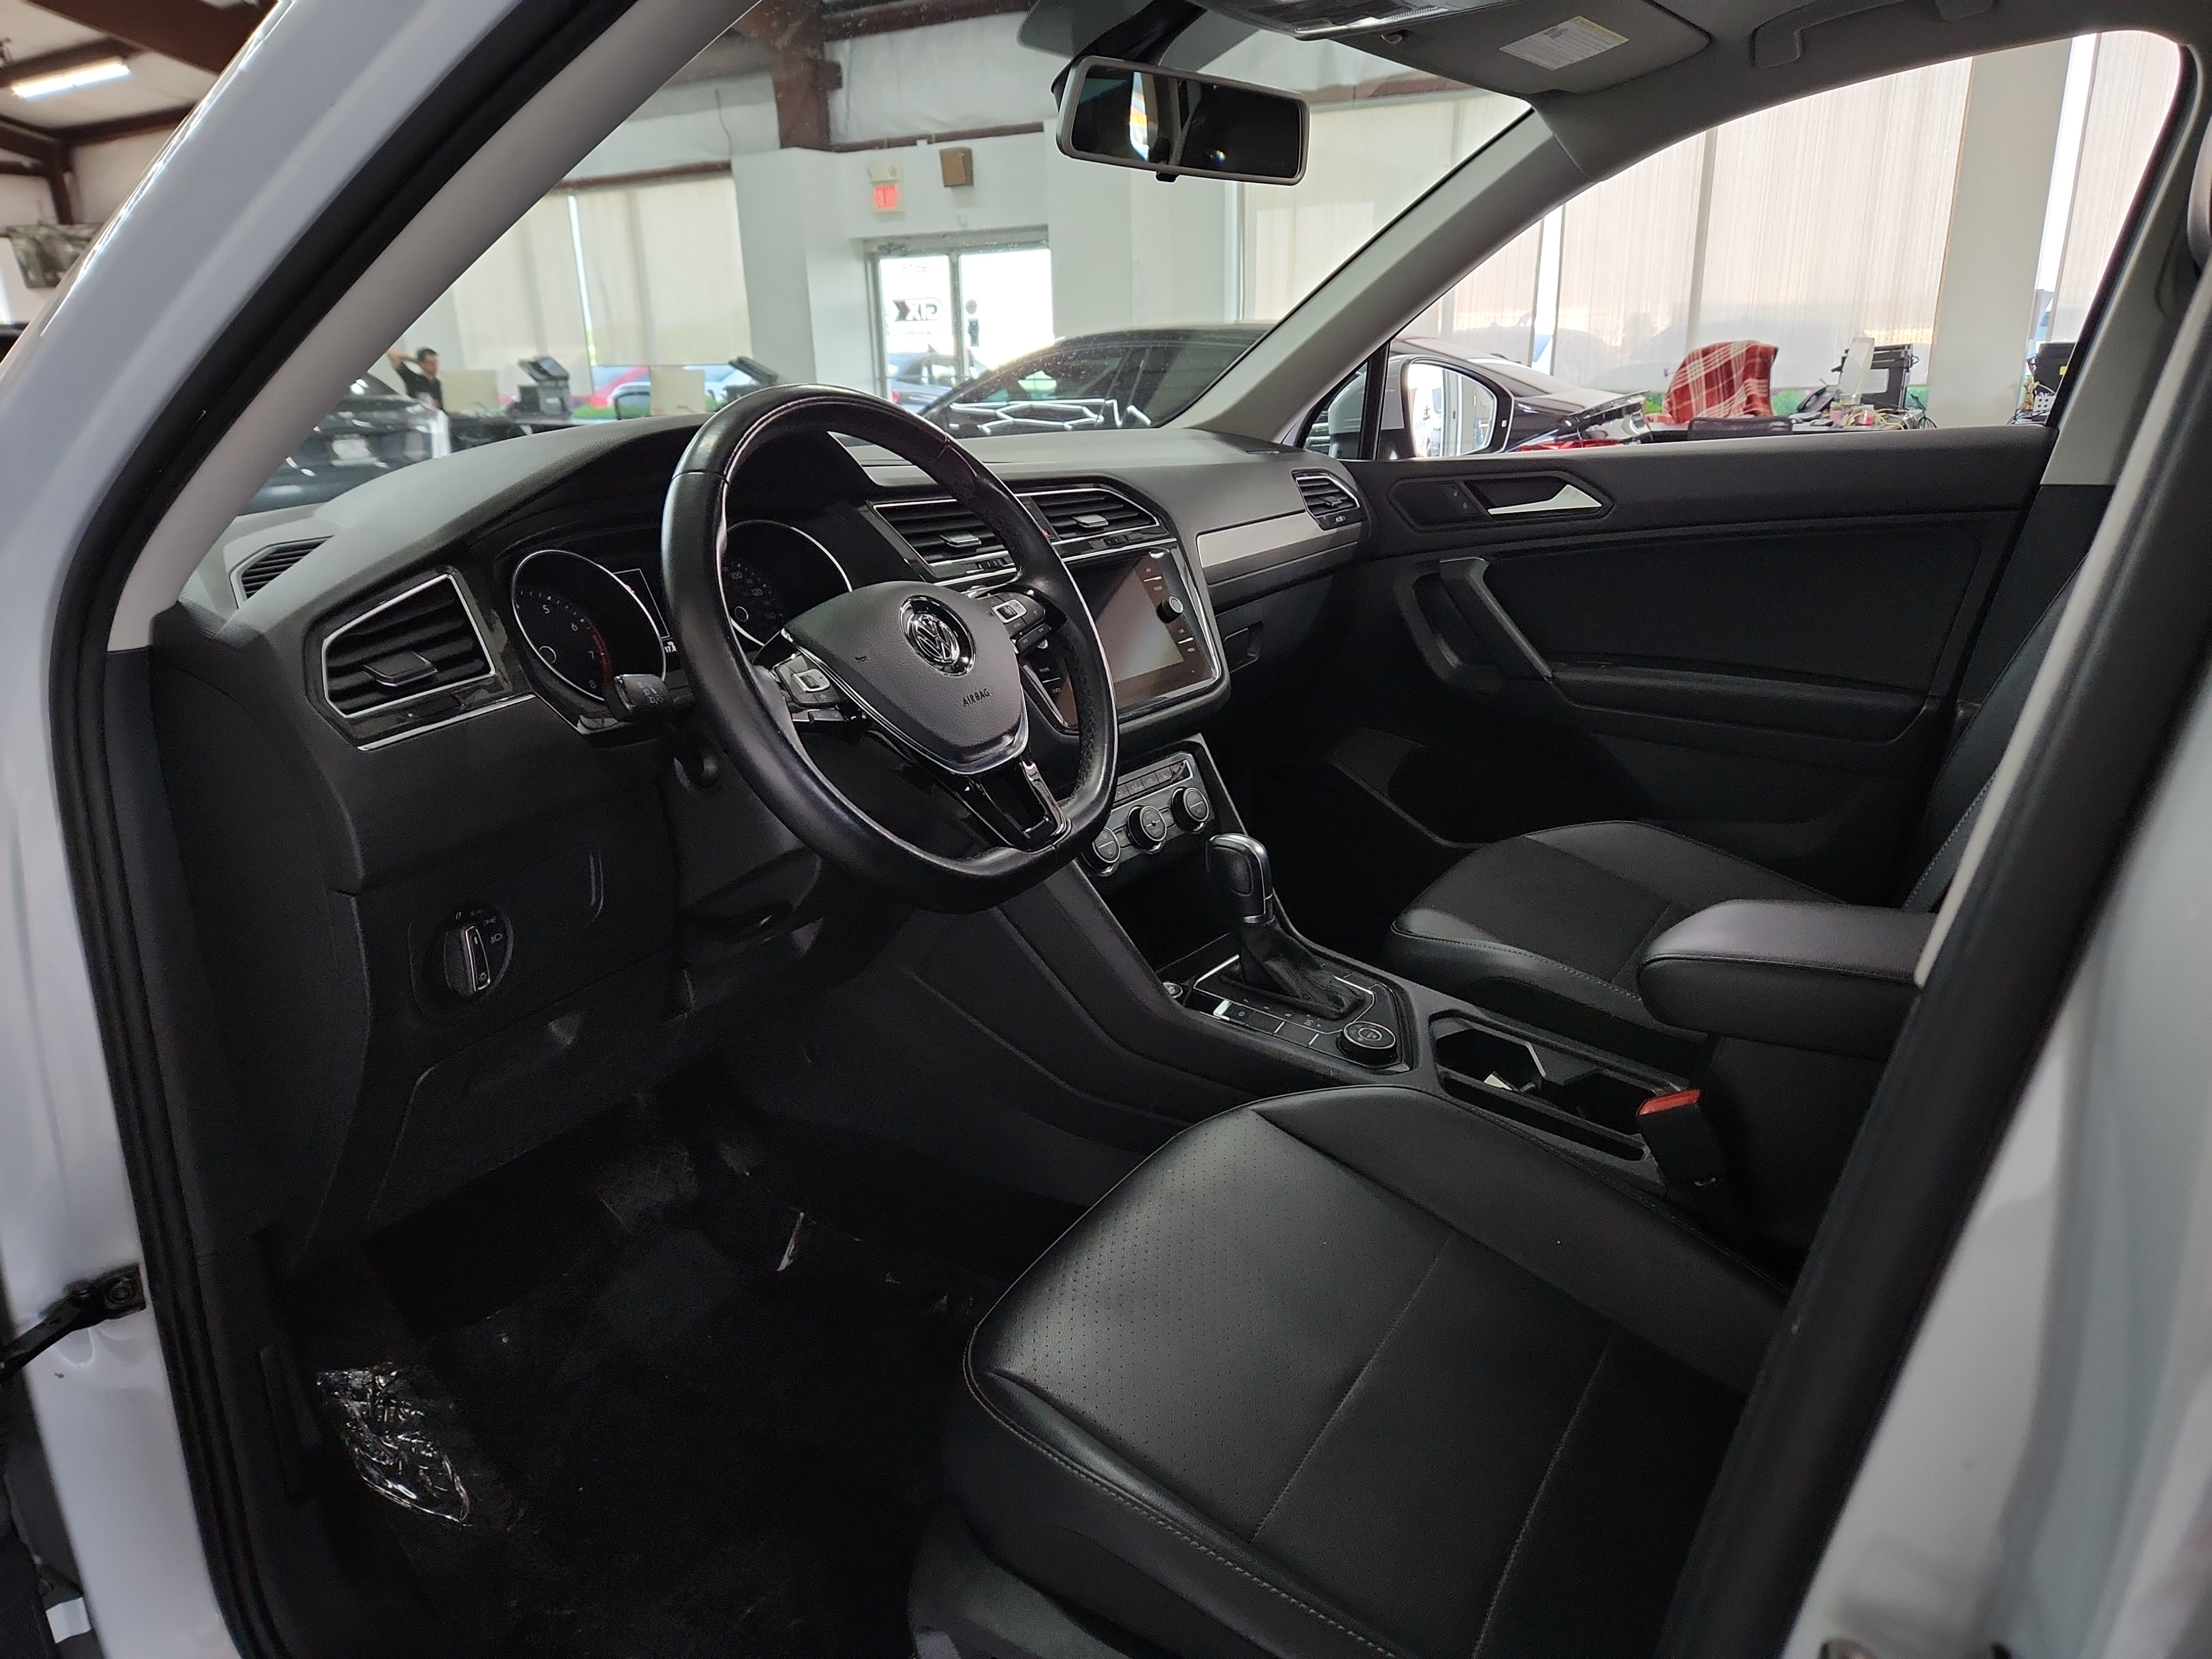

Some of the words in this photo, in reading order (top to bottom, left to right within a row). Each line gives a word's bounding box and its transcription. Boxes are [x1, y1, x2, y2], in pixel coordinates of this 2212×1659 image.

[543, 605, 550, 614] 5
[571, 622, 578, 631] 6
[588, 651, 595, 660] 7
[589, 680, 597, 689] 8
[962, 688, 990, 707] AIRBAG
